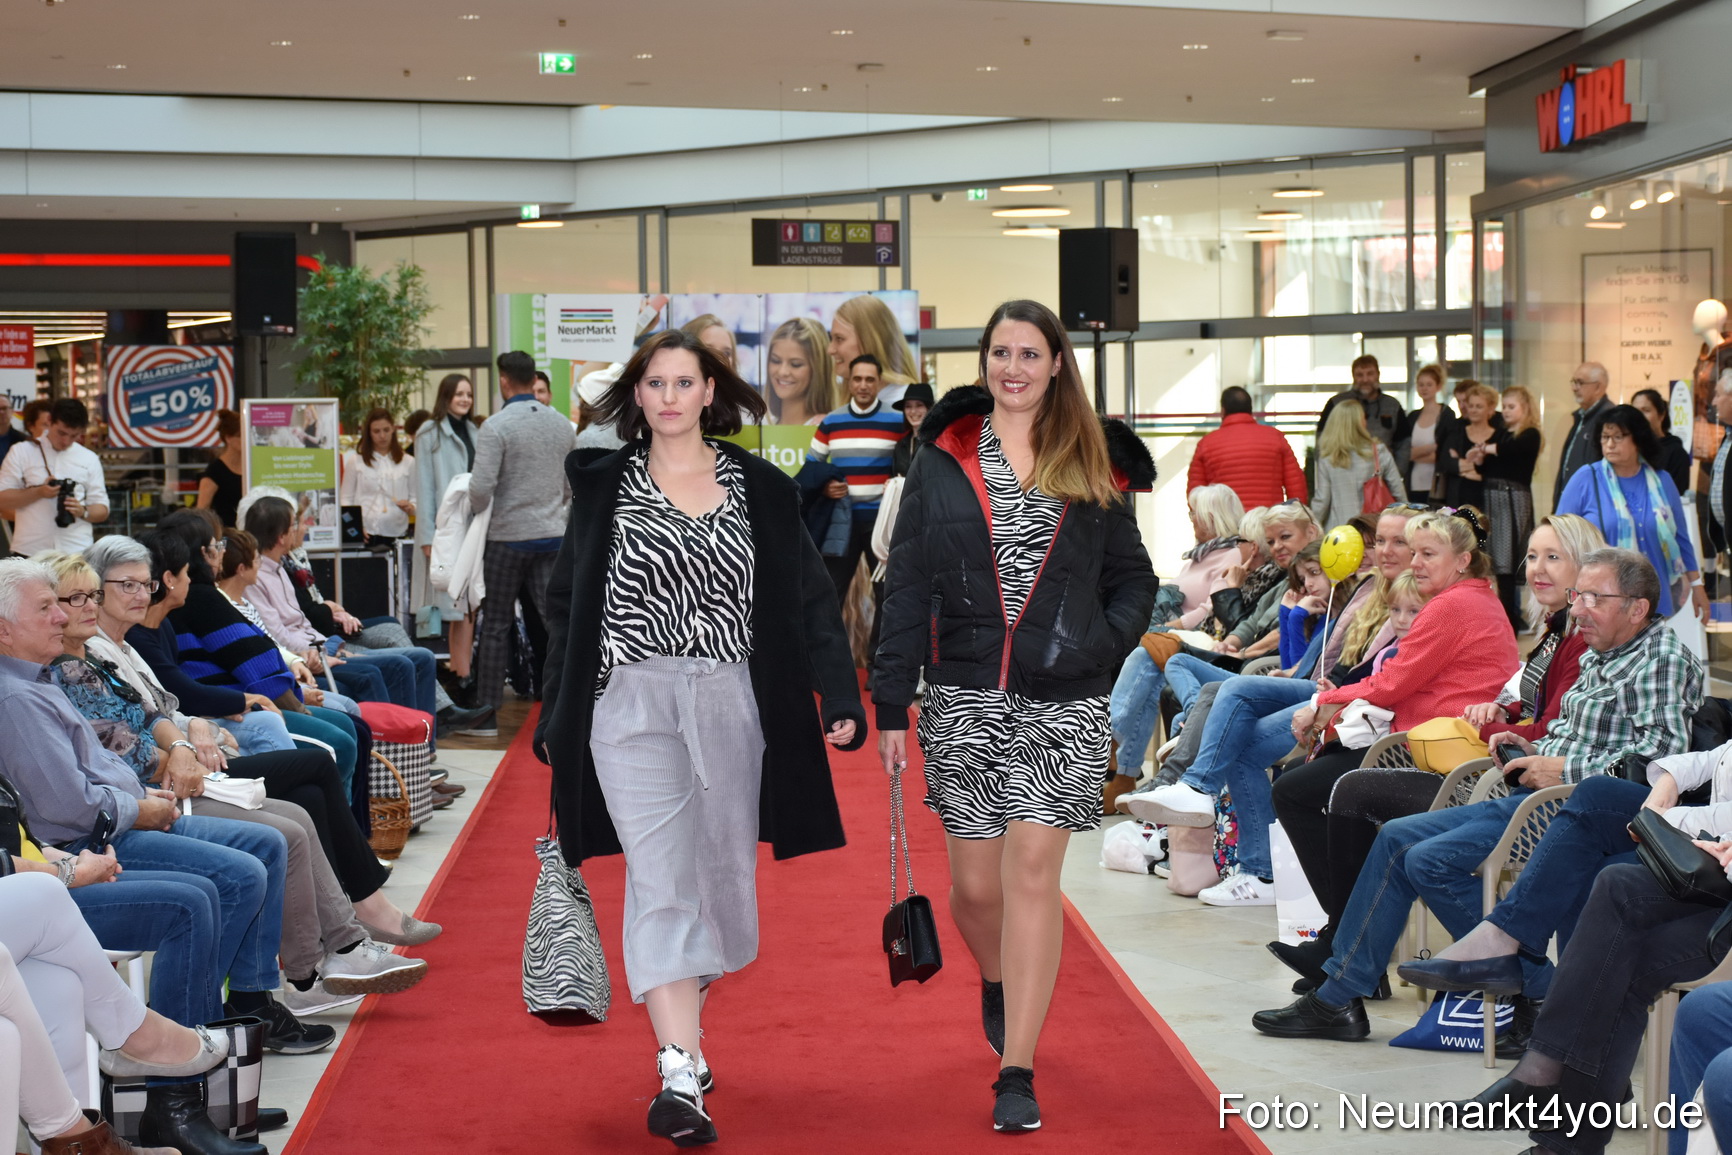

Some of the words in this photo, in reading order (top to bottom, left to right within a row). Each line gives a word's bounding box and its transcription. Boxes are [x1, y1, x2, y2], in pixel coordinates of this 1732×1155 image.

[1536, 58, 1631, 154] WÖHRL
[781, 245, 789, 254] IN
[791, 245, 804, 254] DER
[807, 245, 843, 254] UNTEREN
[781, 256, 843, 265] LADENSTRASSE
[557, 325, 617, 335] NeuerMarkt
[1648, 339, 1673, 347] WEBER
[1631, 353, 1663, 361] BRAX
[124, 357, 215, 385] TOTALABVERKAUF
[1296, 928, 1321, 938] WÖ
